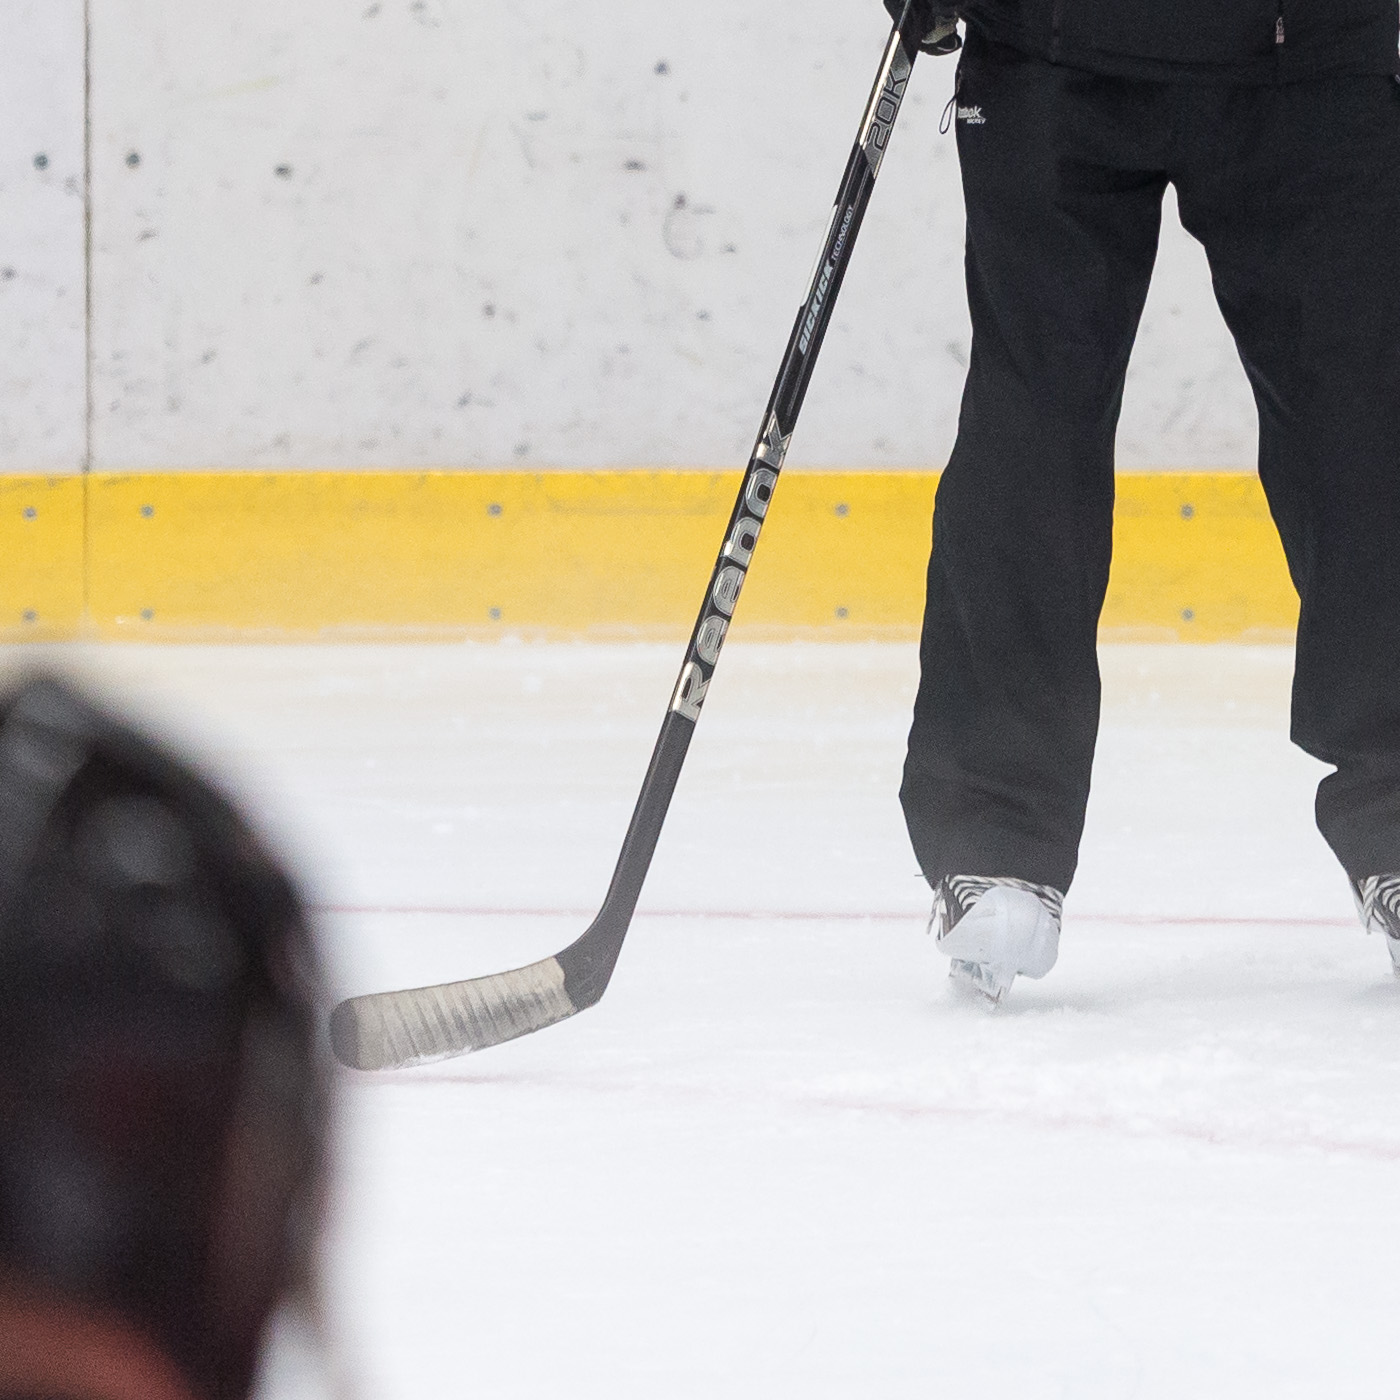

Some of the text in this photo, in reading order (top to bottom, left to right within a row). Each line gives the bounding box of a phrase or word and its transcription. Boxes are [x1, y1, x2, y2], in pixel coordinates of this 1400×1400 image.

[866, 69, 907, 151] 20K
[830, 203, 854, 262] TECHNOLOGY
[670, 409, 794, 723] Reebok
